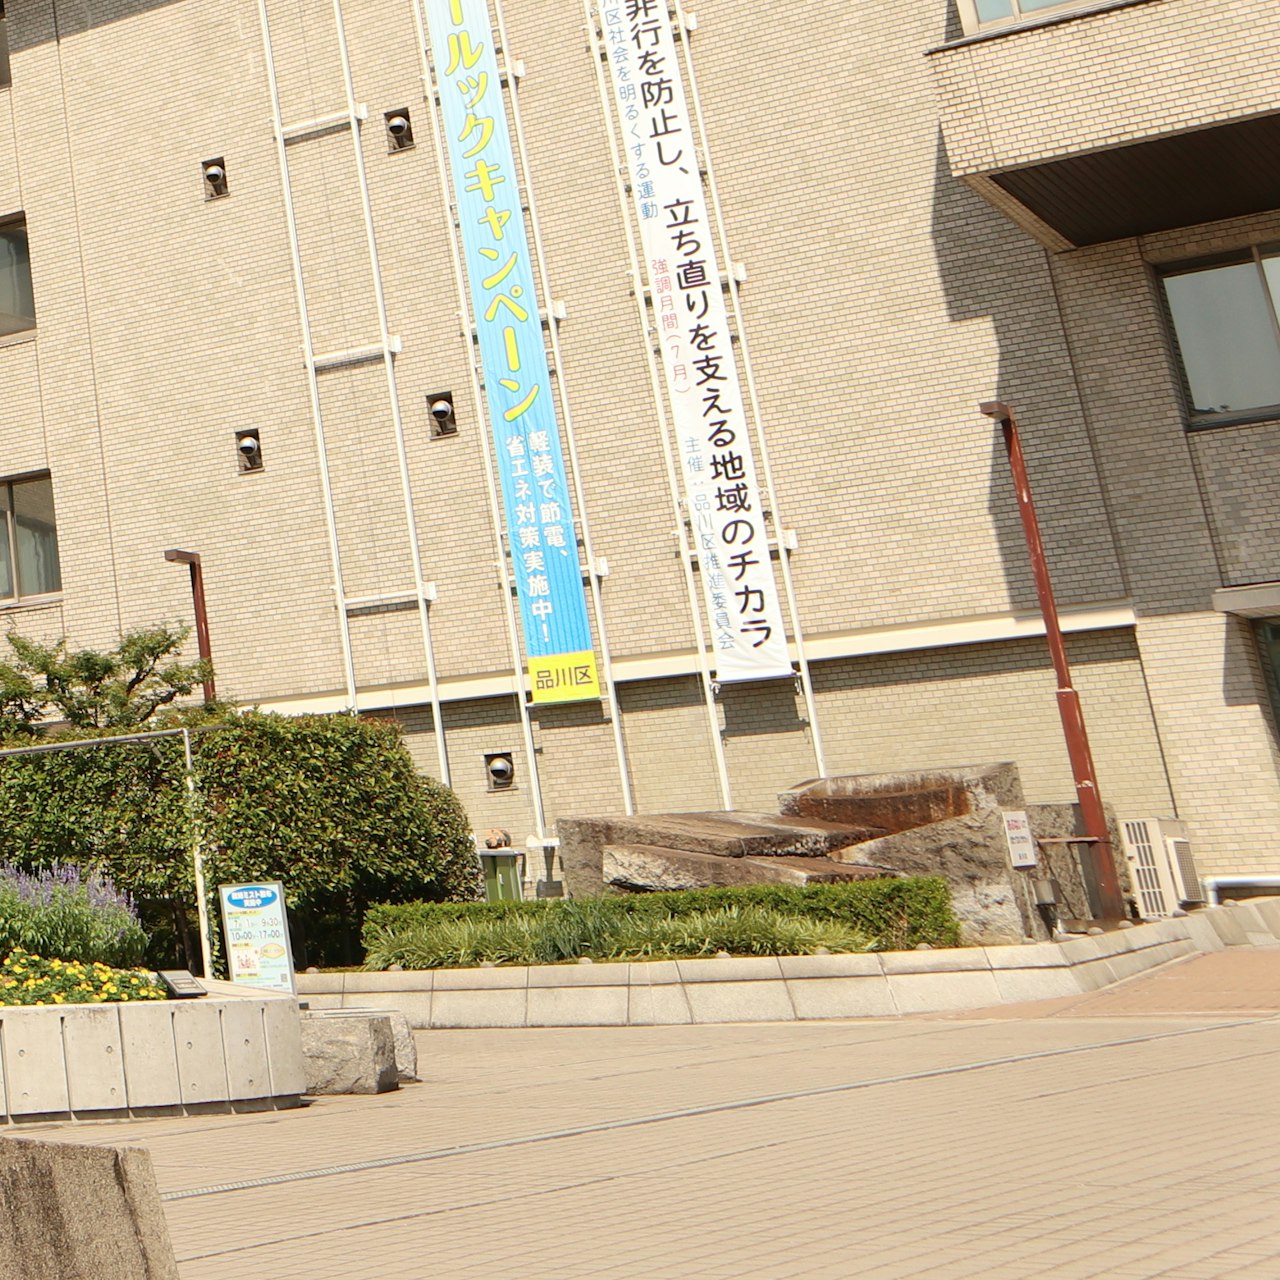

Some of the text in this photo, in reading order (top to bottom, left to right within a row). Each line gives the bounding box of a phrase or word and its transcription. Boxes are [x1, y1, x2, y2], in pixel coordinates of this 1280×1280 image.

[505, 435, 553, 643] 省エネ対策実施中！
[528, 430, 568, 557] 軽装で節電、
[535, 665, 593, 690] 品川区
